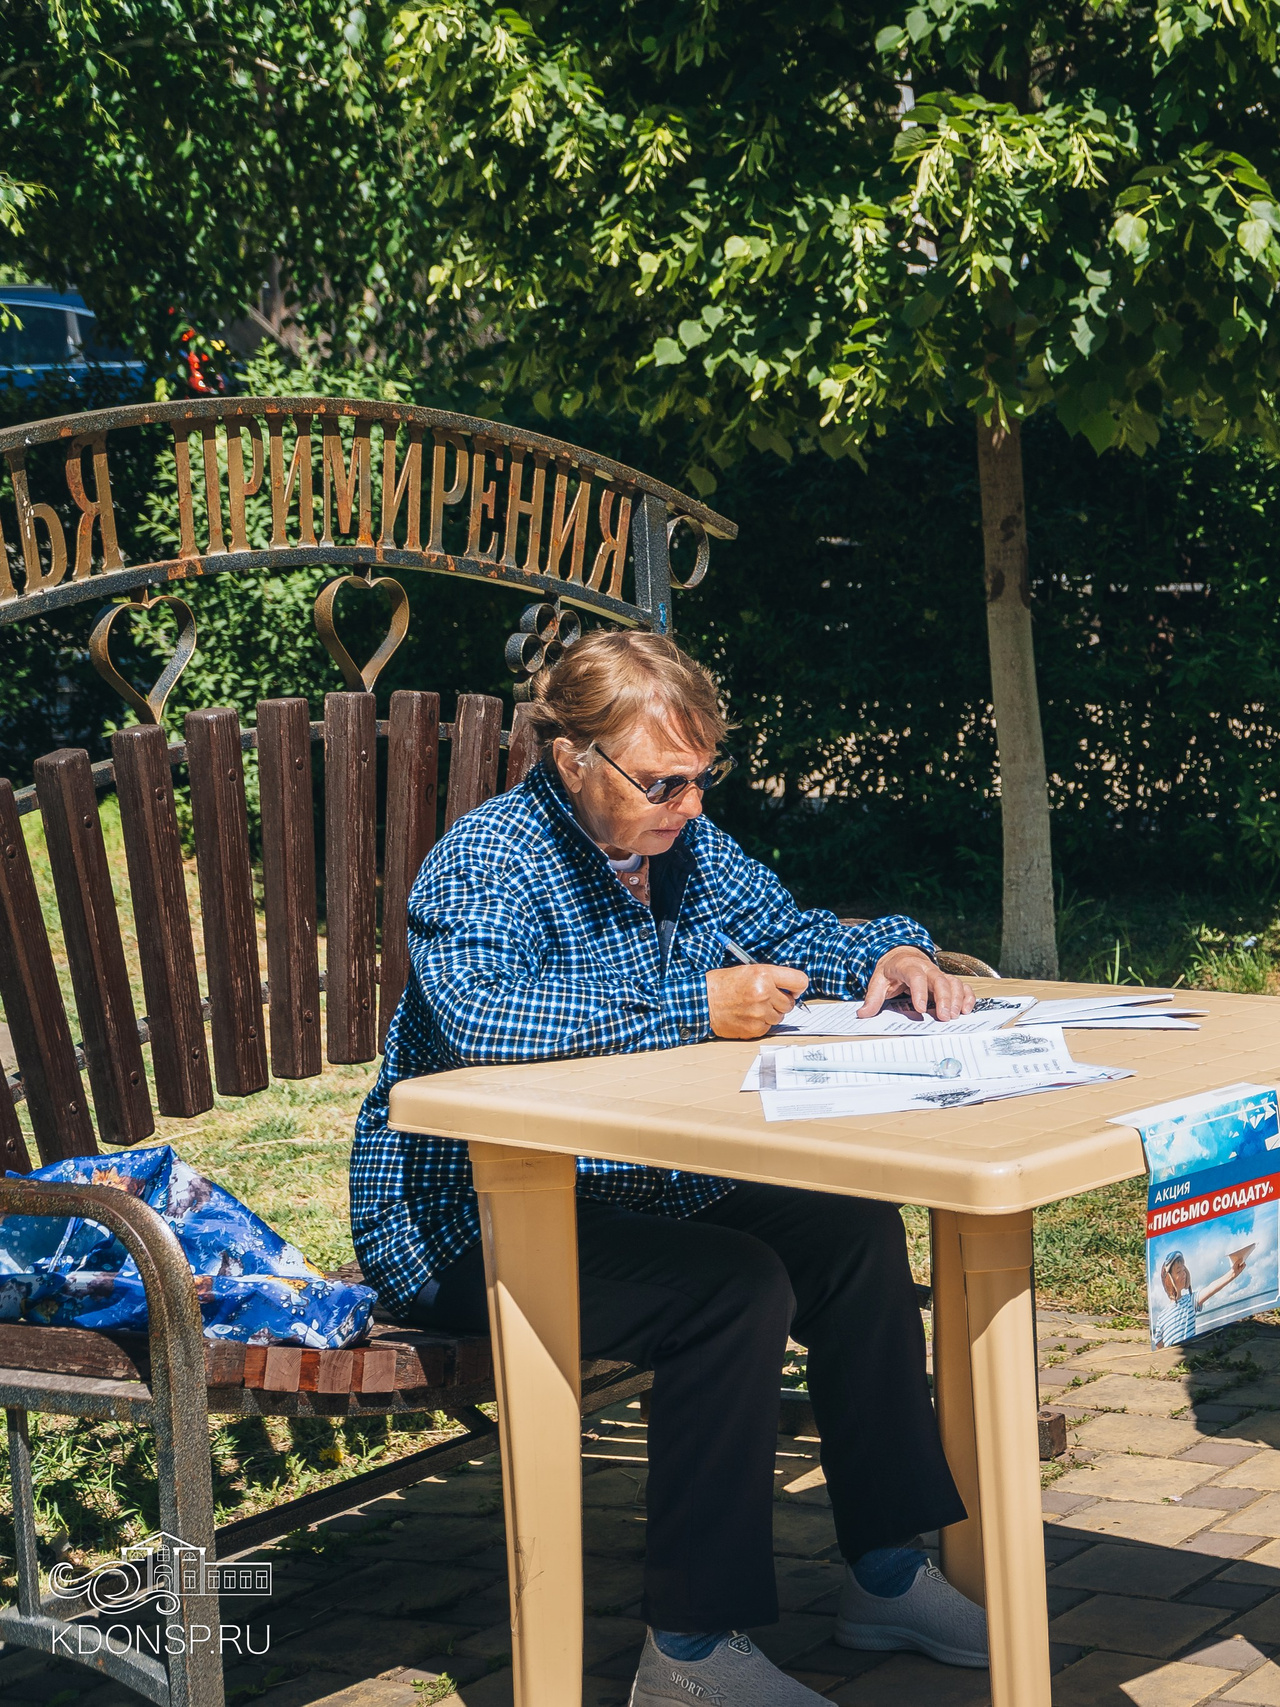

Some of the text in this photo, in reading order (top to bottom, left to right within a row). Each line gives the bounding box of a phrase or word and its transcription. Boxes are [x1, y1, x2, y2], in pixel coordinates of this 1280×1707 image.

[0, 411, 637, 600] ЬЯ ПРИМИРЕНИЯ
[1148, 1180, 1274, 1232] «ПИСЬМО СОЛДАТУ»
[1154, 1180, 1191, 1204] АКЦИЯ
[670, 1670, 704, 1698] SPORT
